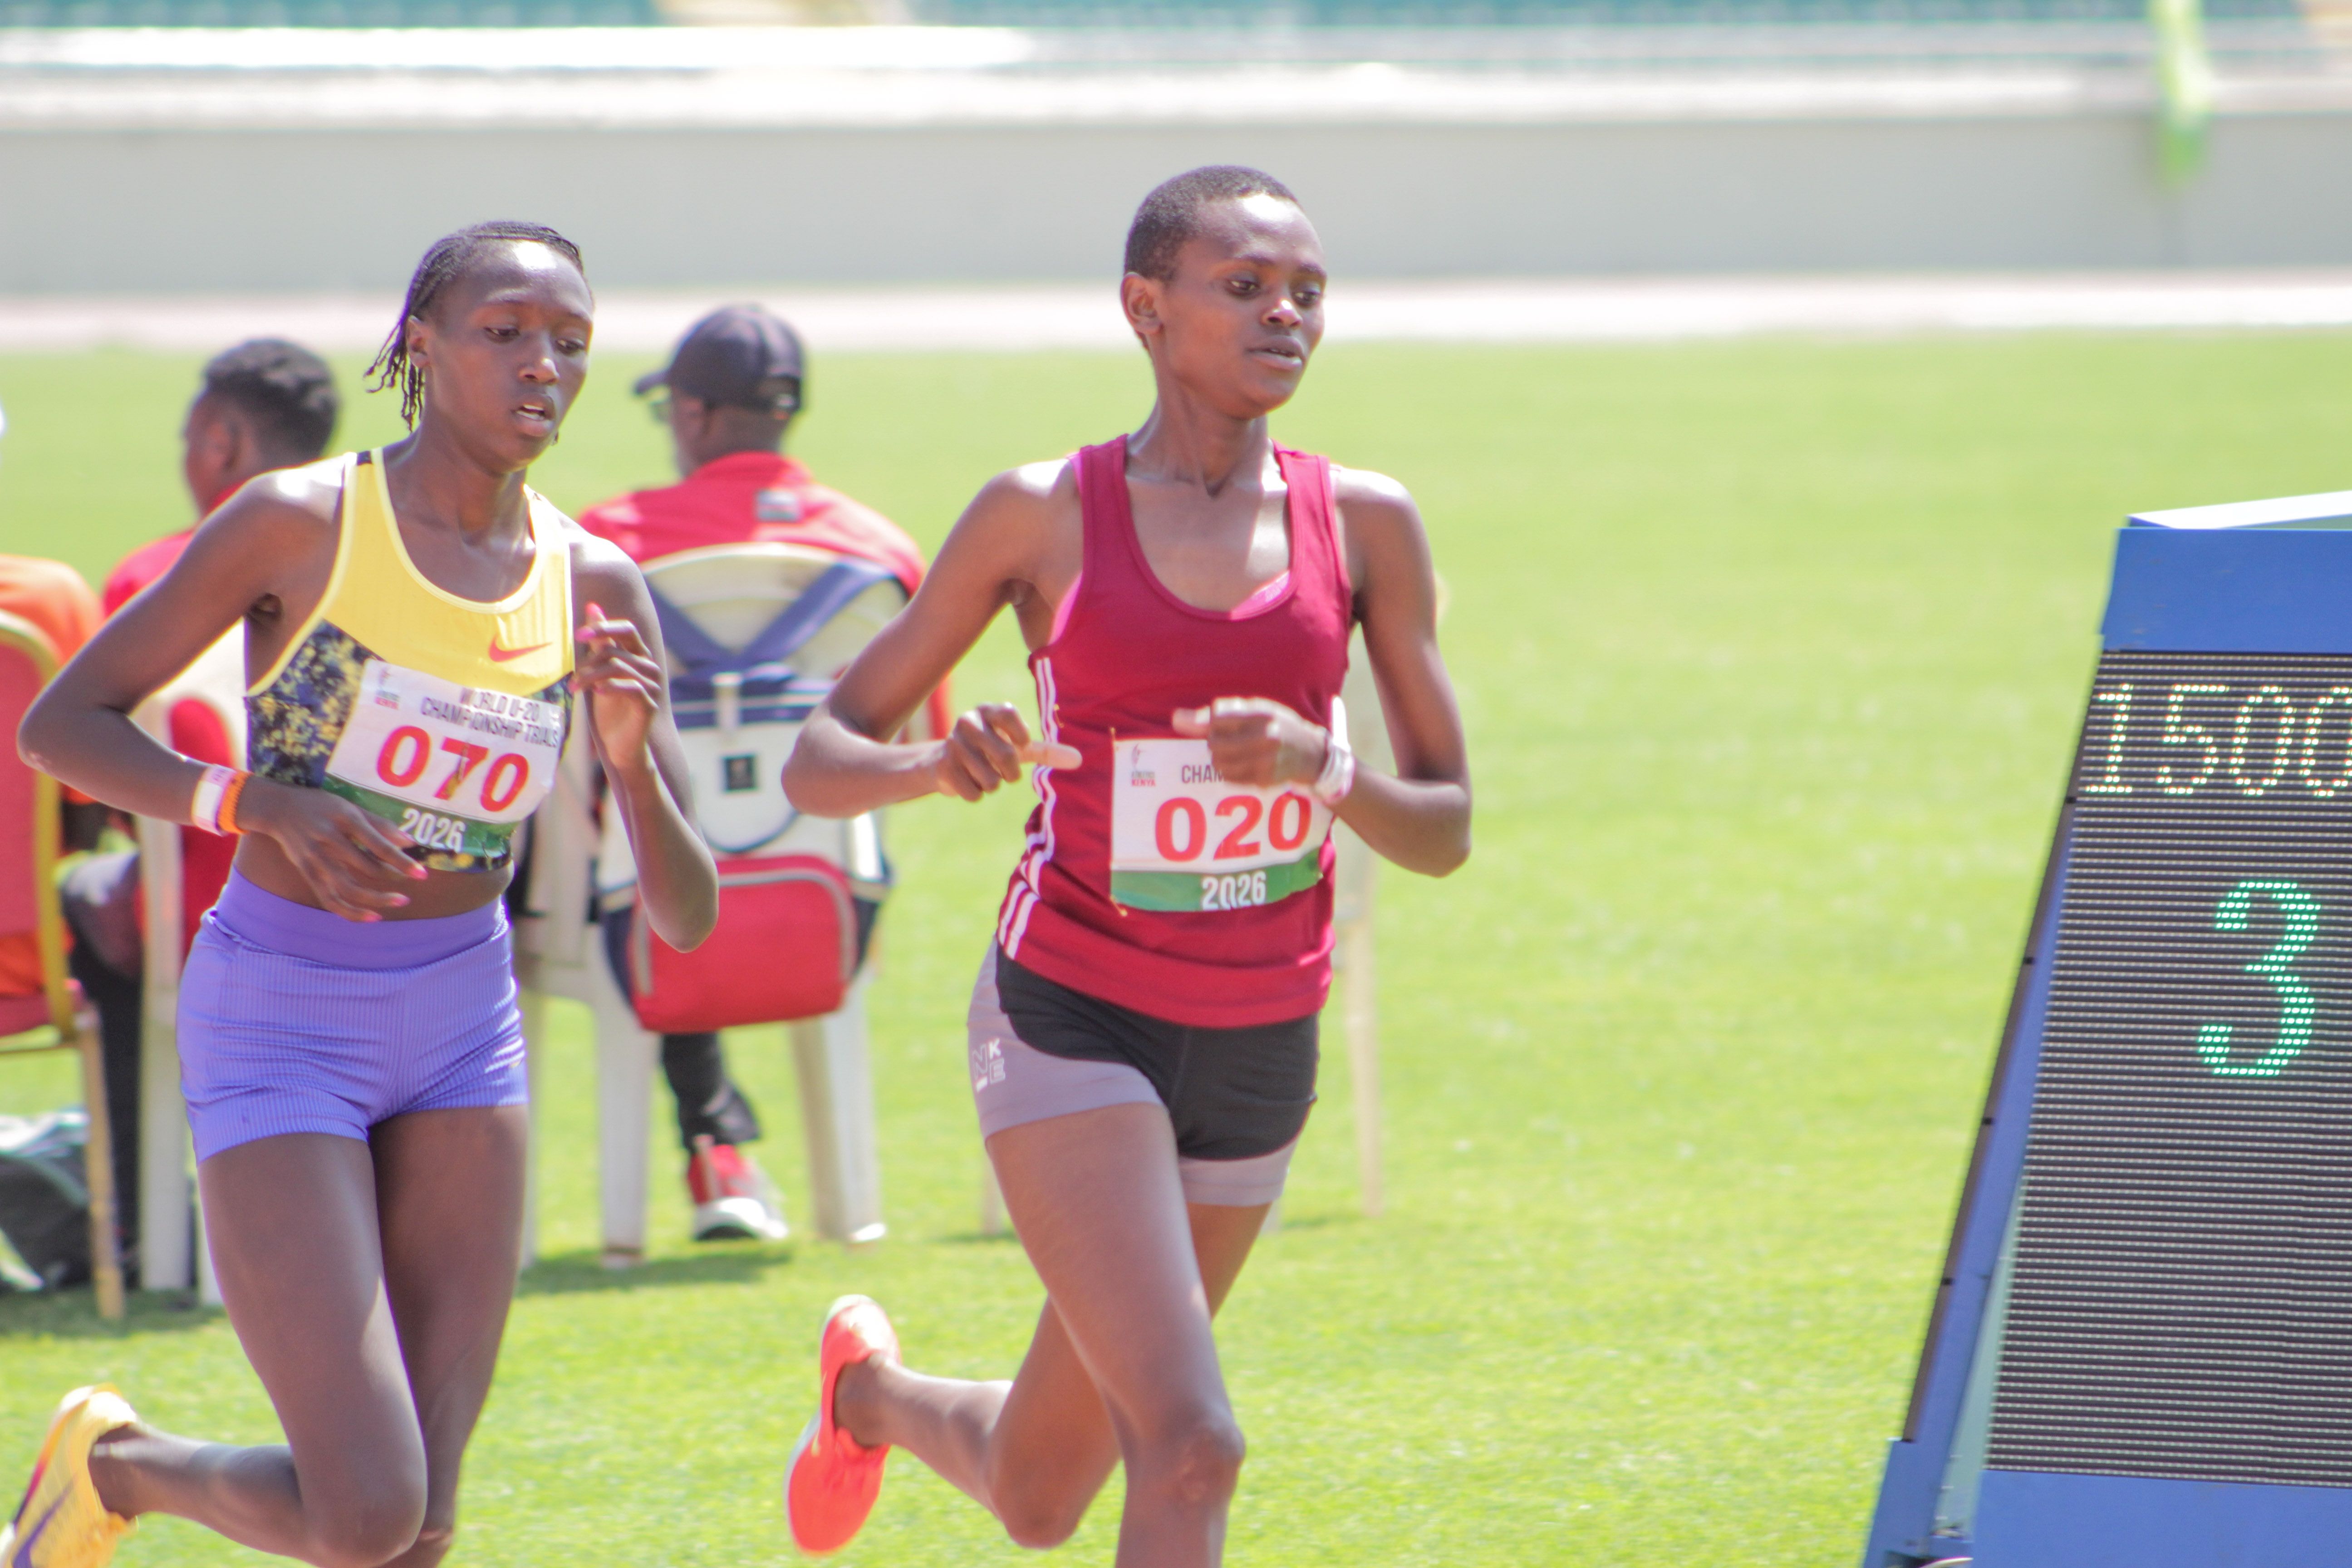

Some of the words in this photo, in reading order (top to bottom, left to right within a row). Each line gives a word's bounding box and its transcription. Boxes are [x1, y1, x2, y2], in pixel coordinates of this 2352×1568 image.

[377, 725, 529, 812] 070
[398, 807, 466, 853] 2026
[1155, 791, 1312, 862] 020
[1201, 871, 1267, 911] 2026
[2197, 881, 2322, 1076] 3
